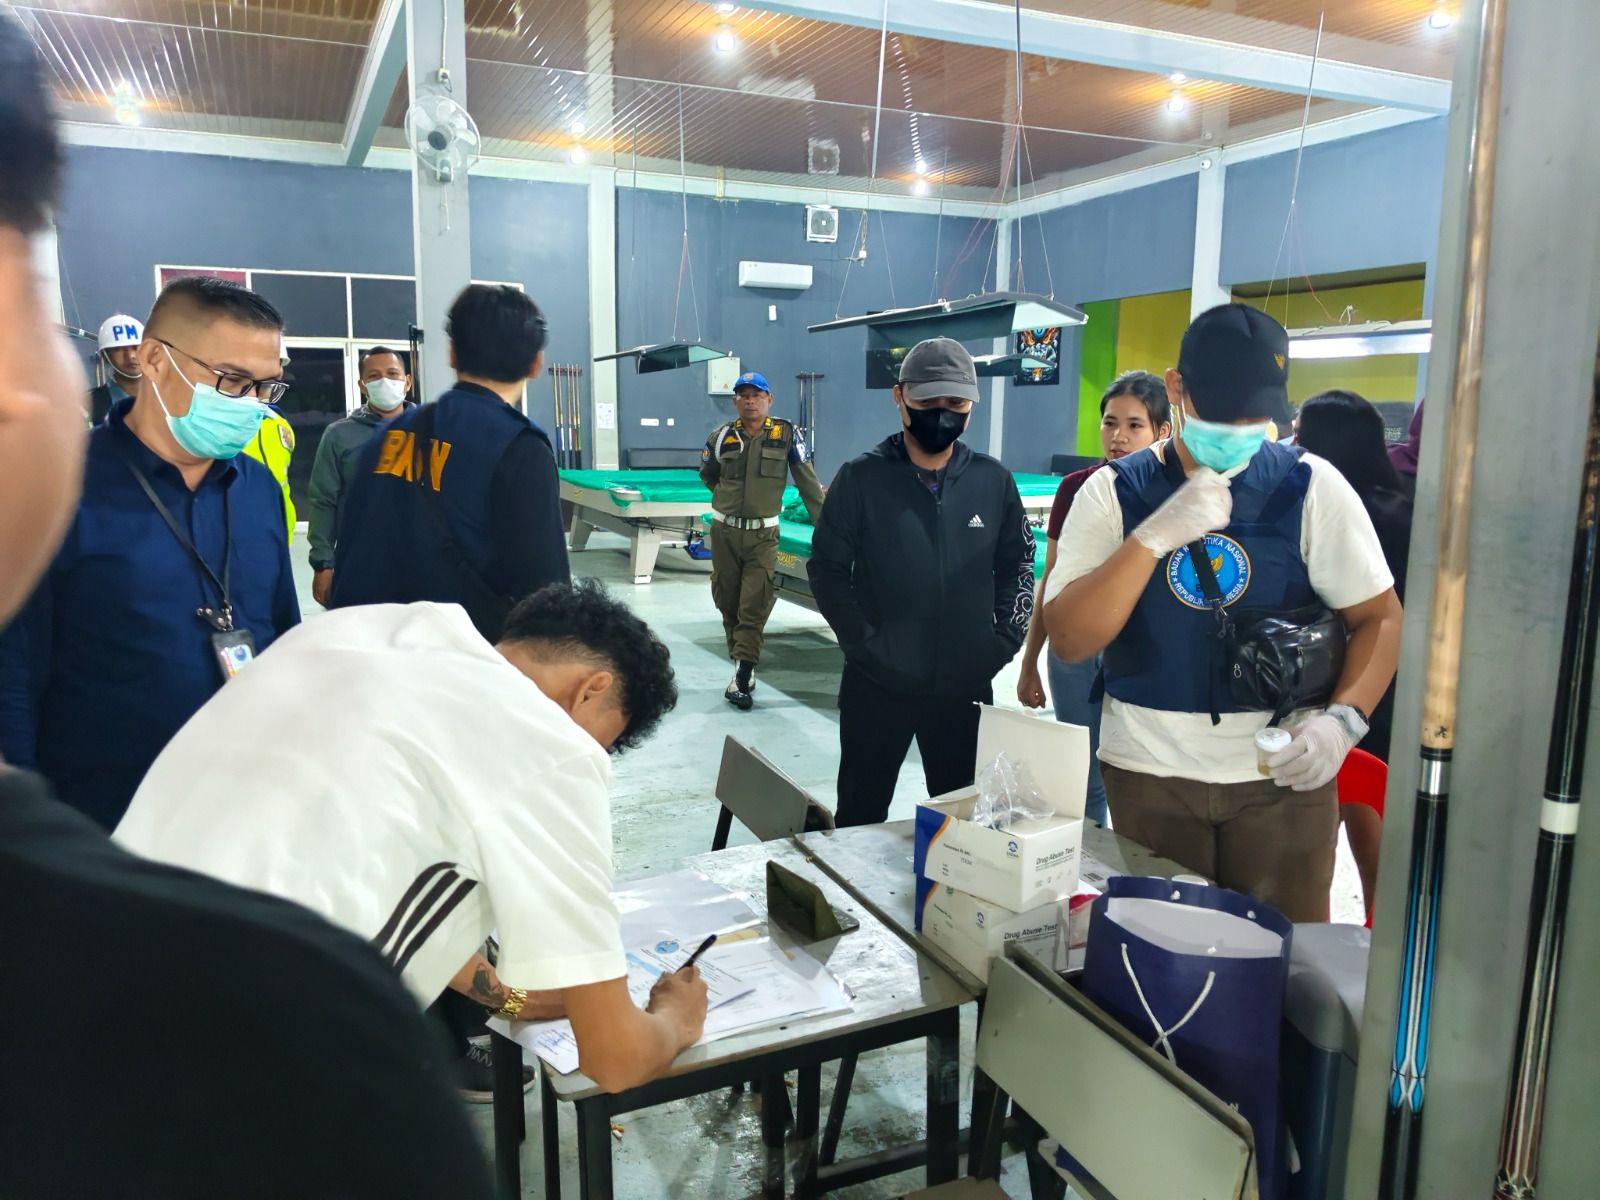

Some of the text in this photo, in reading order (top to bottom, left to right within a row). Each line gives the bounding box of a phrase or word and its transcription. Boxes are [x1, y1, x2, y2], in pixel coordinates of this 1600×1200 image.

[112, 324, 139, 341] PM
[1170, 551, 1185, 576] BADAN
[1224, 542, 1247, 574] NASIONAL
[1223, 583, 1244, 604] NESIA
[1035, 857, 1049, 866] Drug
[1004, 931, 1021, 940] Drug
[1022, 927, 1043, 936] Abuse
